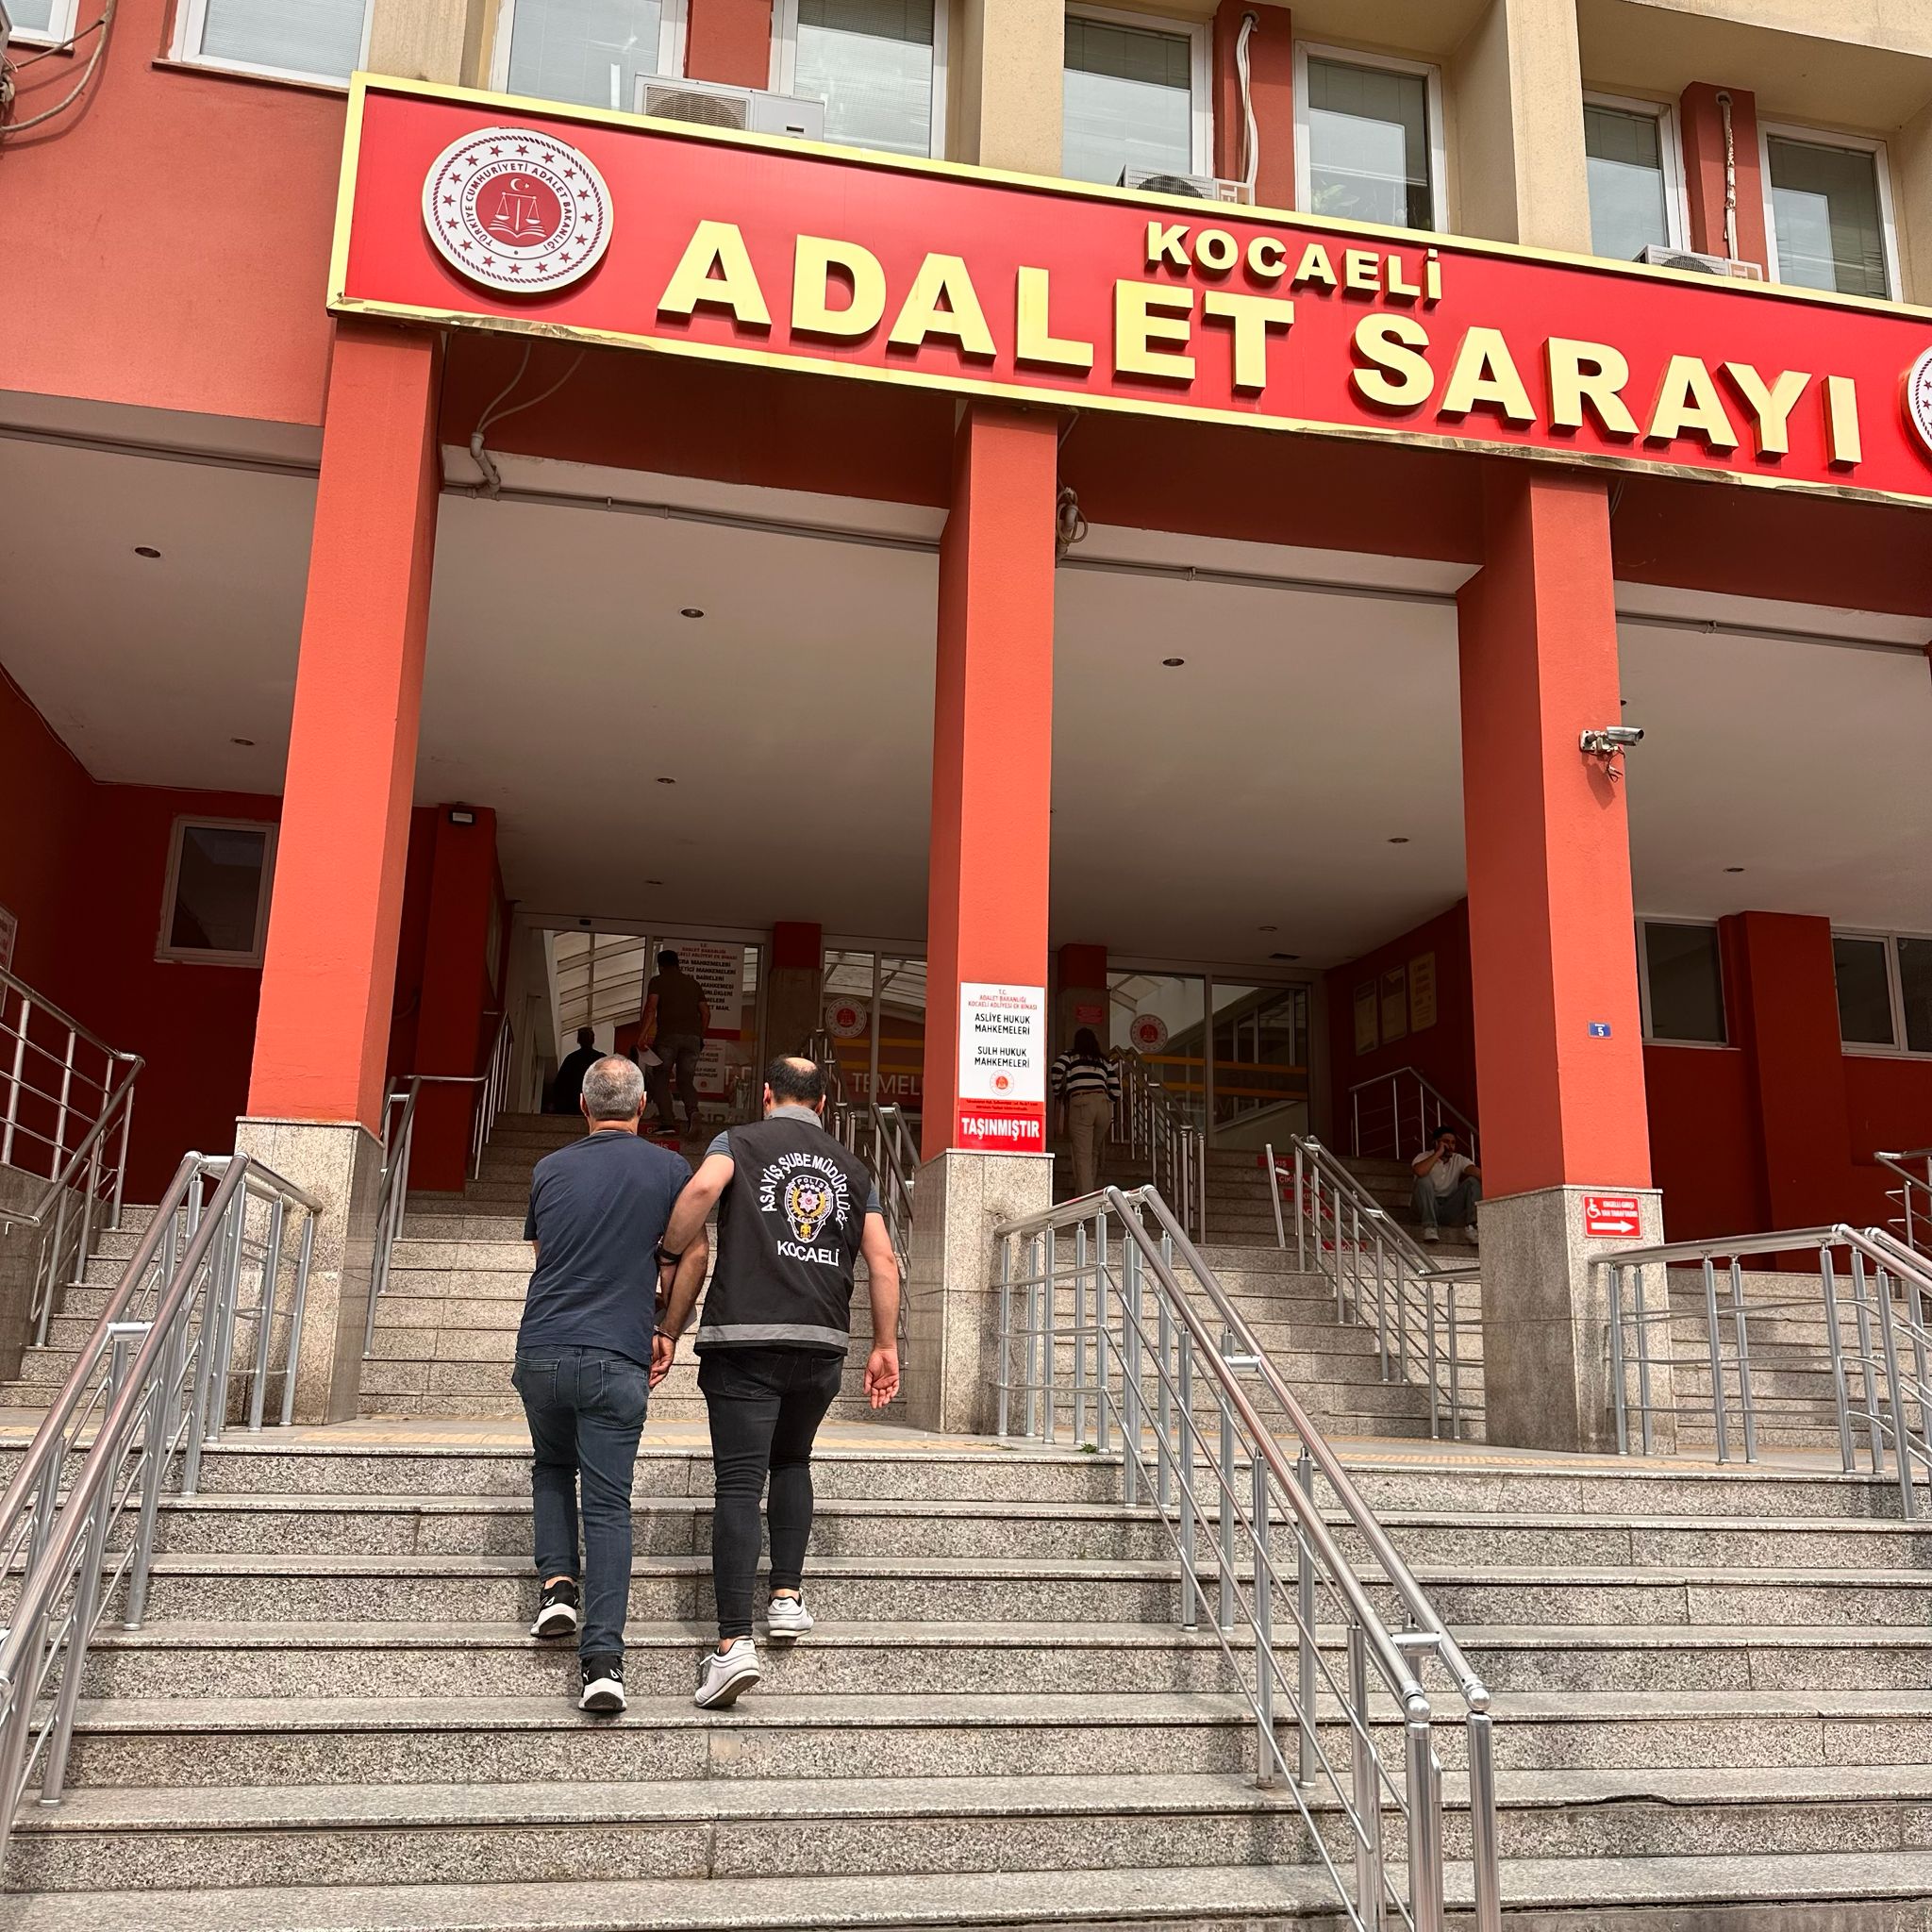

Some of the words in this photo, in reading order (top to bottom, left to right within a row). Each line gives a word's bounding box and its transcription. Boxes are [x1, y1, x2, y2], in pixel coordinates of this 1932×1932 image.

[466, 163, 528, 202] CUMHURİYETİ
[531, 167, 568, 199] ADALET
[465, 206, 493, 247] TÜRKİYE
[542, 201, 573, 251] BAKANLIĞI
[1145, 221, 1442, 305] KOCAELİ
[657, 219, 1295, 392] ADALET
[1351, 312, 1864, 467] SARAYI
[974, 1012, 1002, 1023] ASLİYE
[1003, 1014, 1030, 1024] HUKUK
[974, 1024, 1030, 1035] MAHKEMELERİ
[1597, 1026, 1605, 1037] 5
[974, 1057, 1030, 1068] MAHKEMELERİ
[977, 1045, 998, 1055] SULH
[999, 1047, 1027, 1057] HUKUK
[852, 1072, 921, 1095] TEMEL
[960, 1117, 1041, 1141] TAŞINMIŞTIR
[759, 1164, 786, 1212] ASAYİŞ
[777, 1152, 811, 1174] ŞUBE
[811, 1155, 851, 1231] MÜDÜRLÜĞ
[797, 1178, 825, 1189] POLİS
[776, 1240, 841, 1267] KOCAELİ
